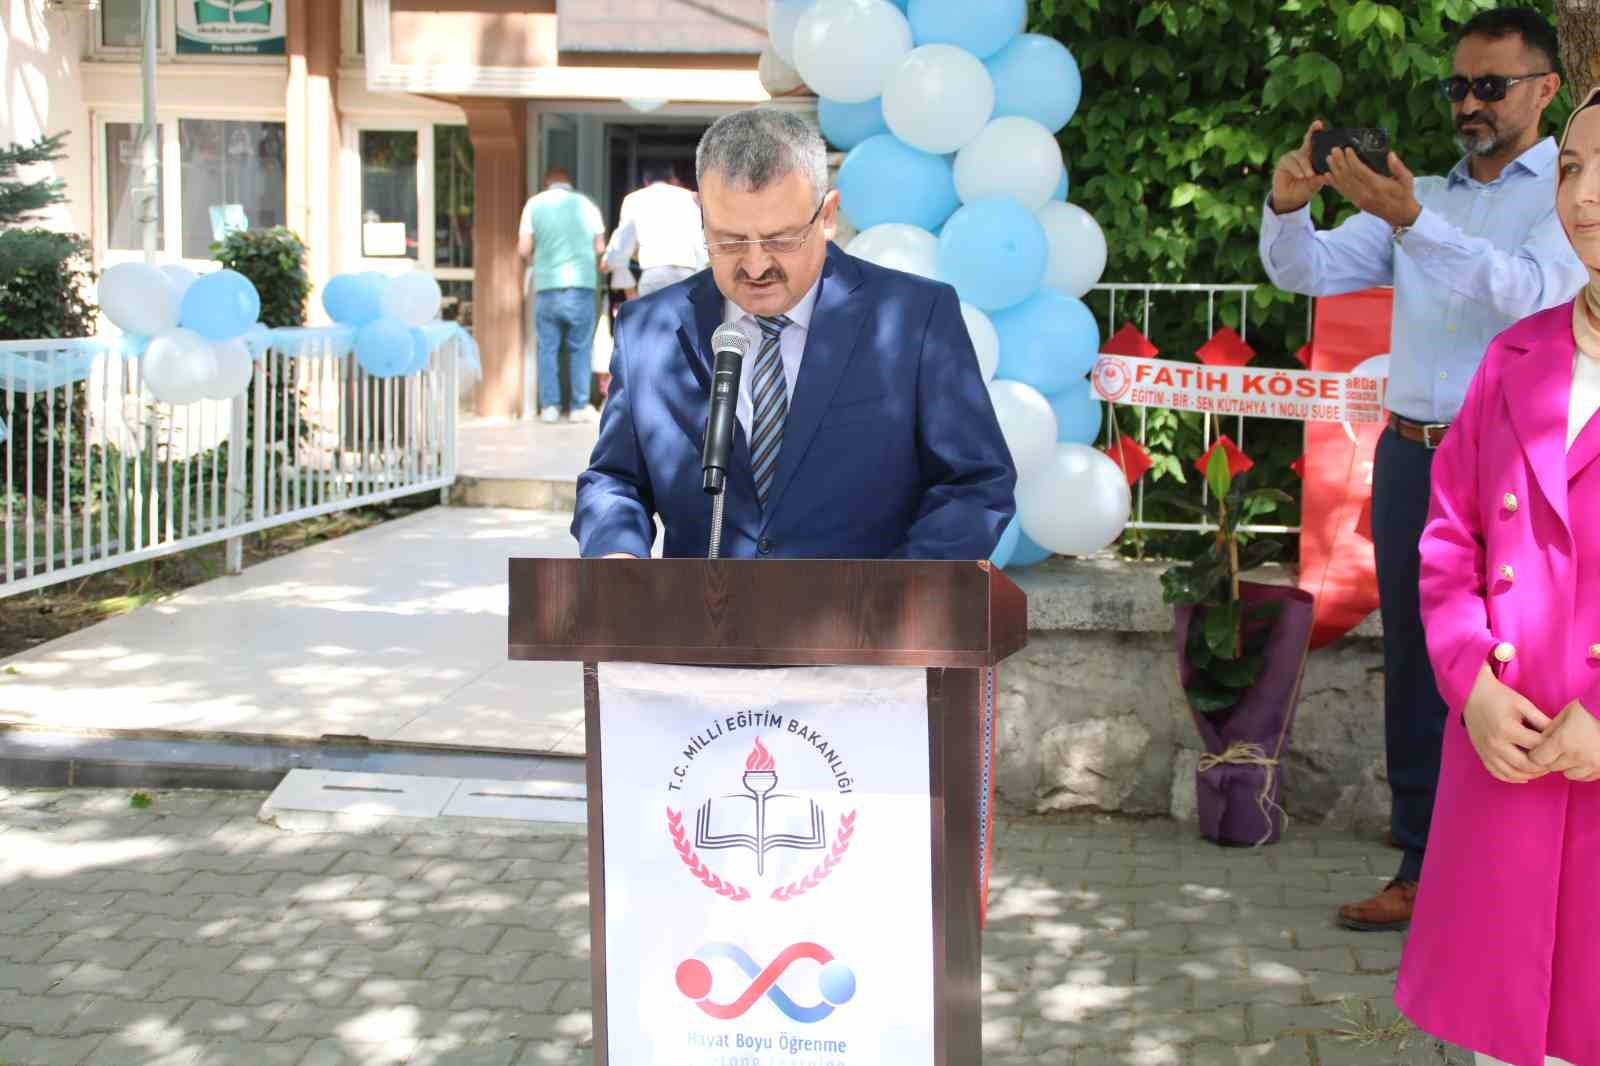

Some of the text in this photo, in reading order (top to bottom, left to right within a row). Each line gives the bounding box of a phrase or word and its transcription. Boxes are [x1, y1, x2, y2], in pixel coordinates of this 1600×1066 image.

[1135, 364, 1229, 392] FATİH
[1242, 371, 1340, 399] KÖSE
[668, 710, 854, 794] T.C. MİLLİ EĞİTİM BAKANLIĞI
[736, 1033, 773, 1053] Boyu
